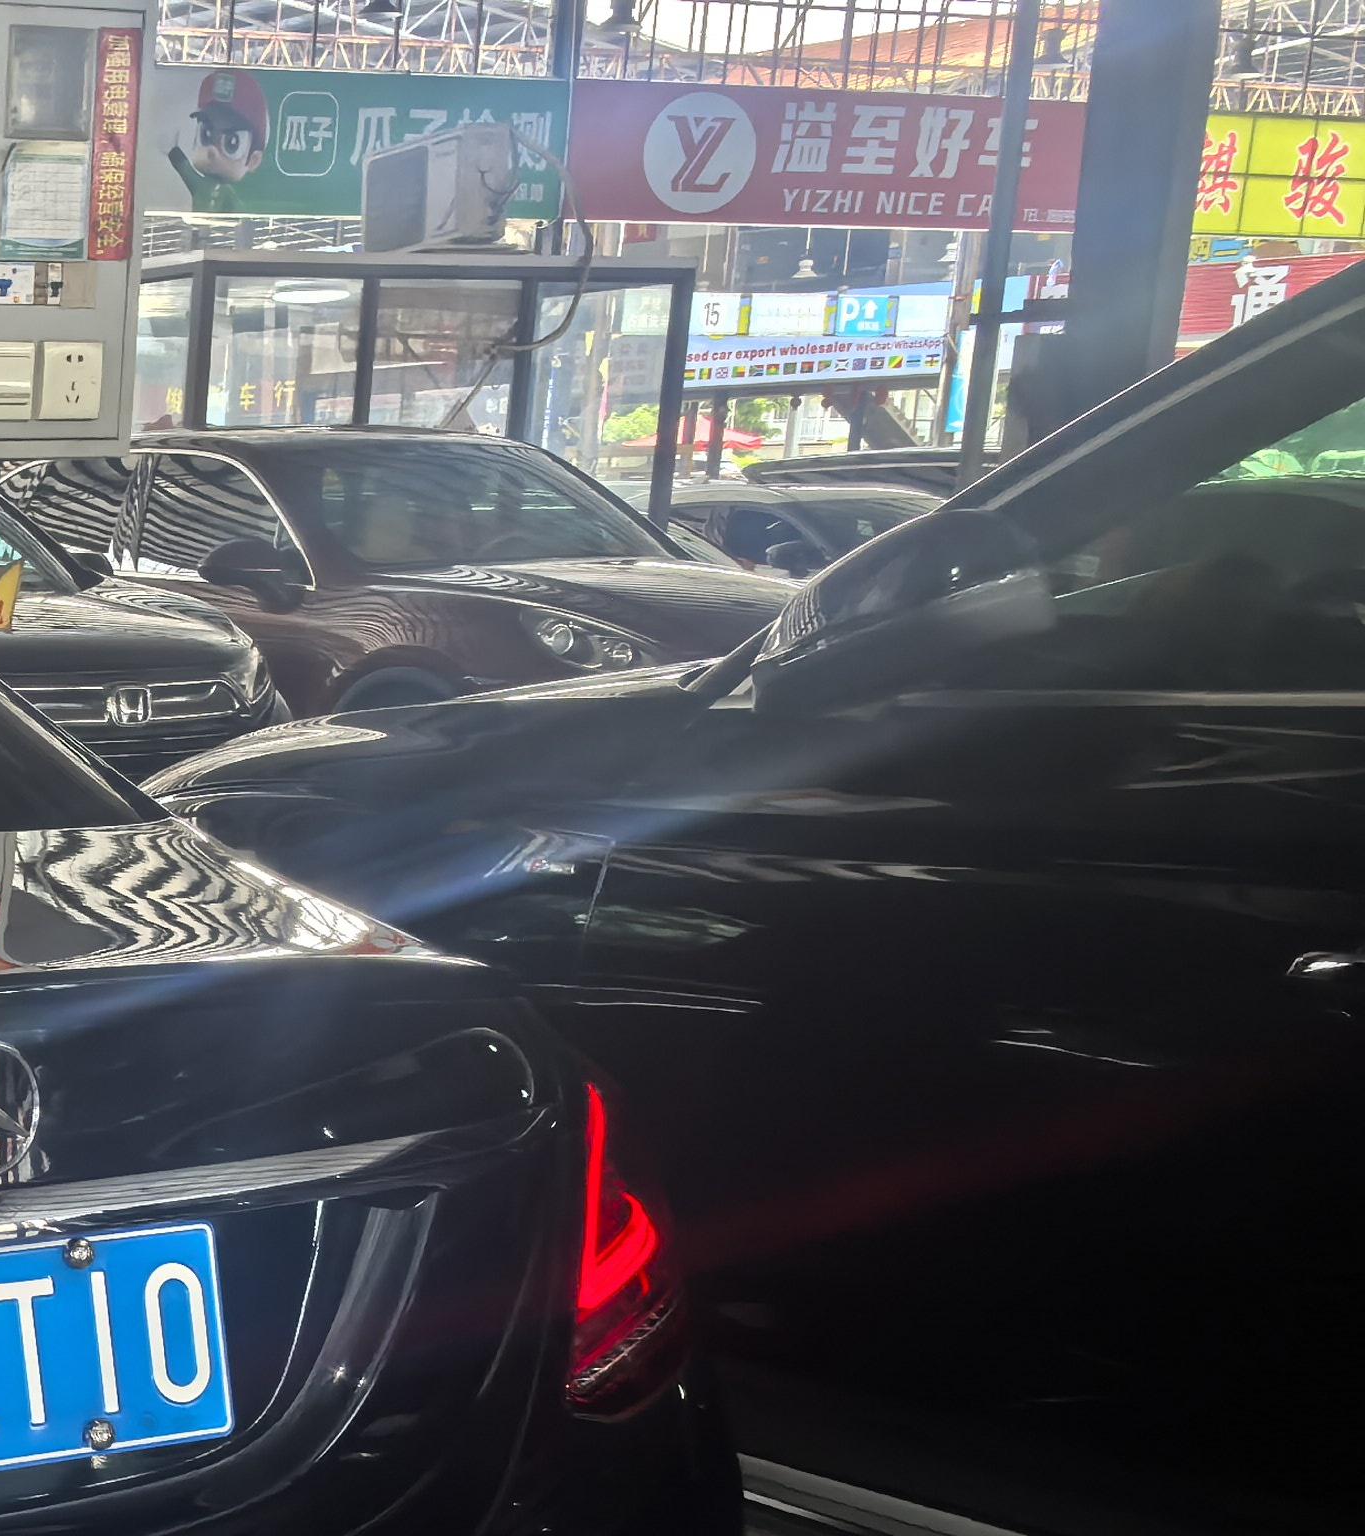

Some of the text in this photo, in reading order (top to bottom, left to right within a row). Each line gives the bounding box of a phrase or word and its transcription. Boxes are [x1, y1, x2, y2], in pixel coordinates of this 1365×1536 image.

[283, 116, 335, 152] 瓜子
[782, 188, 995, 218] YIZHI NICE CA
[684, 348, 711, 364] sed
[711, 349, 733, 363] car
[735, 345, 777, 364] export
[779, 340, 854, 358] wholesaler
